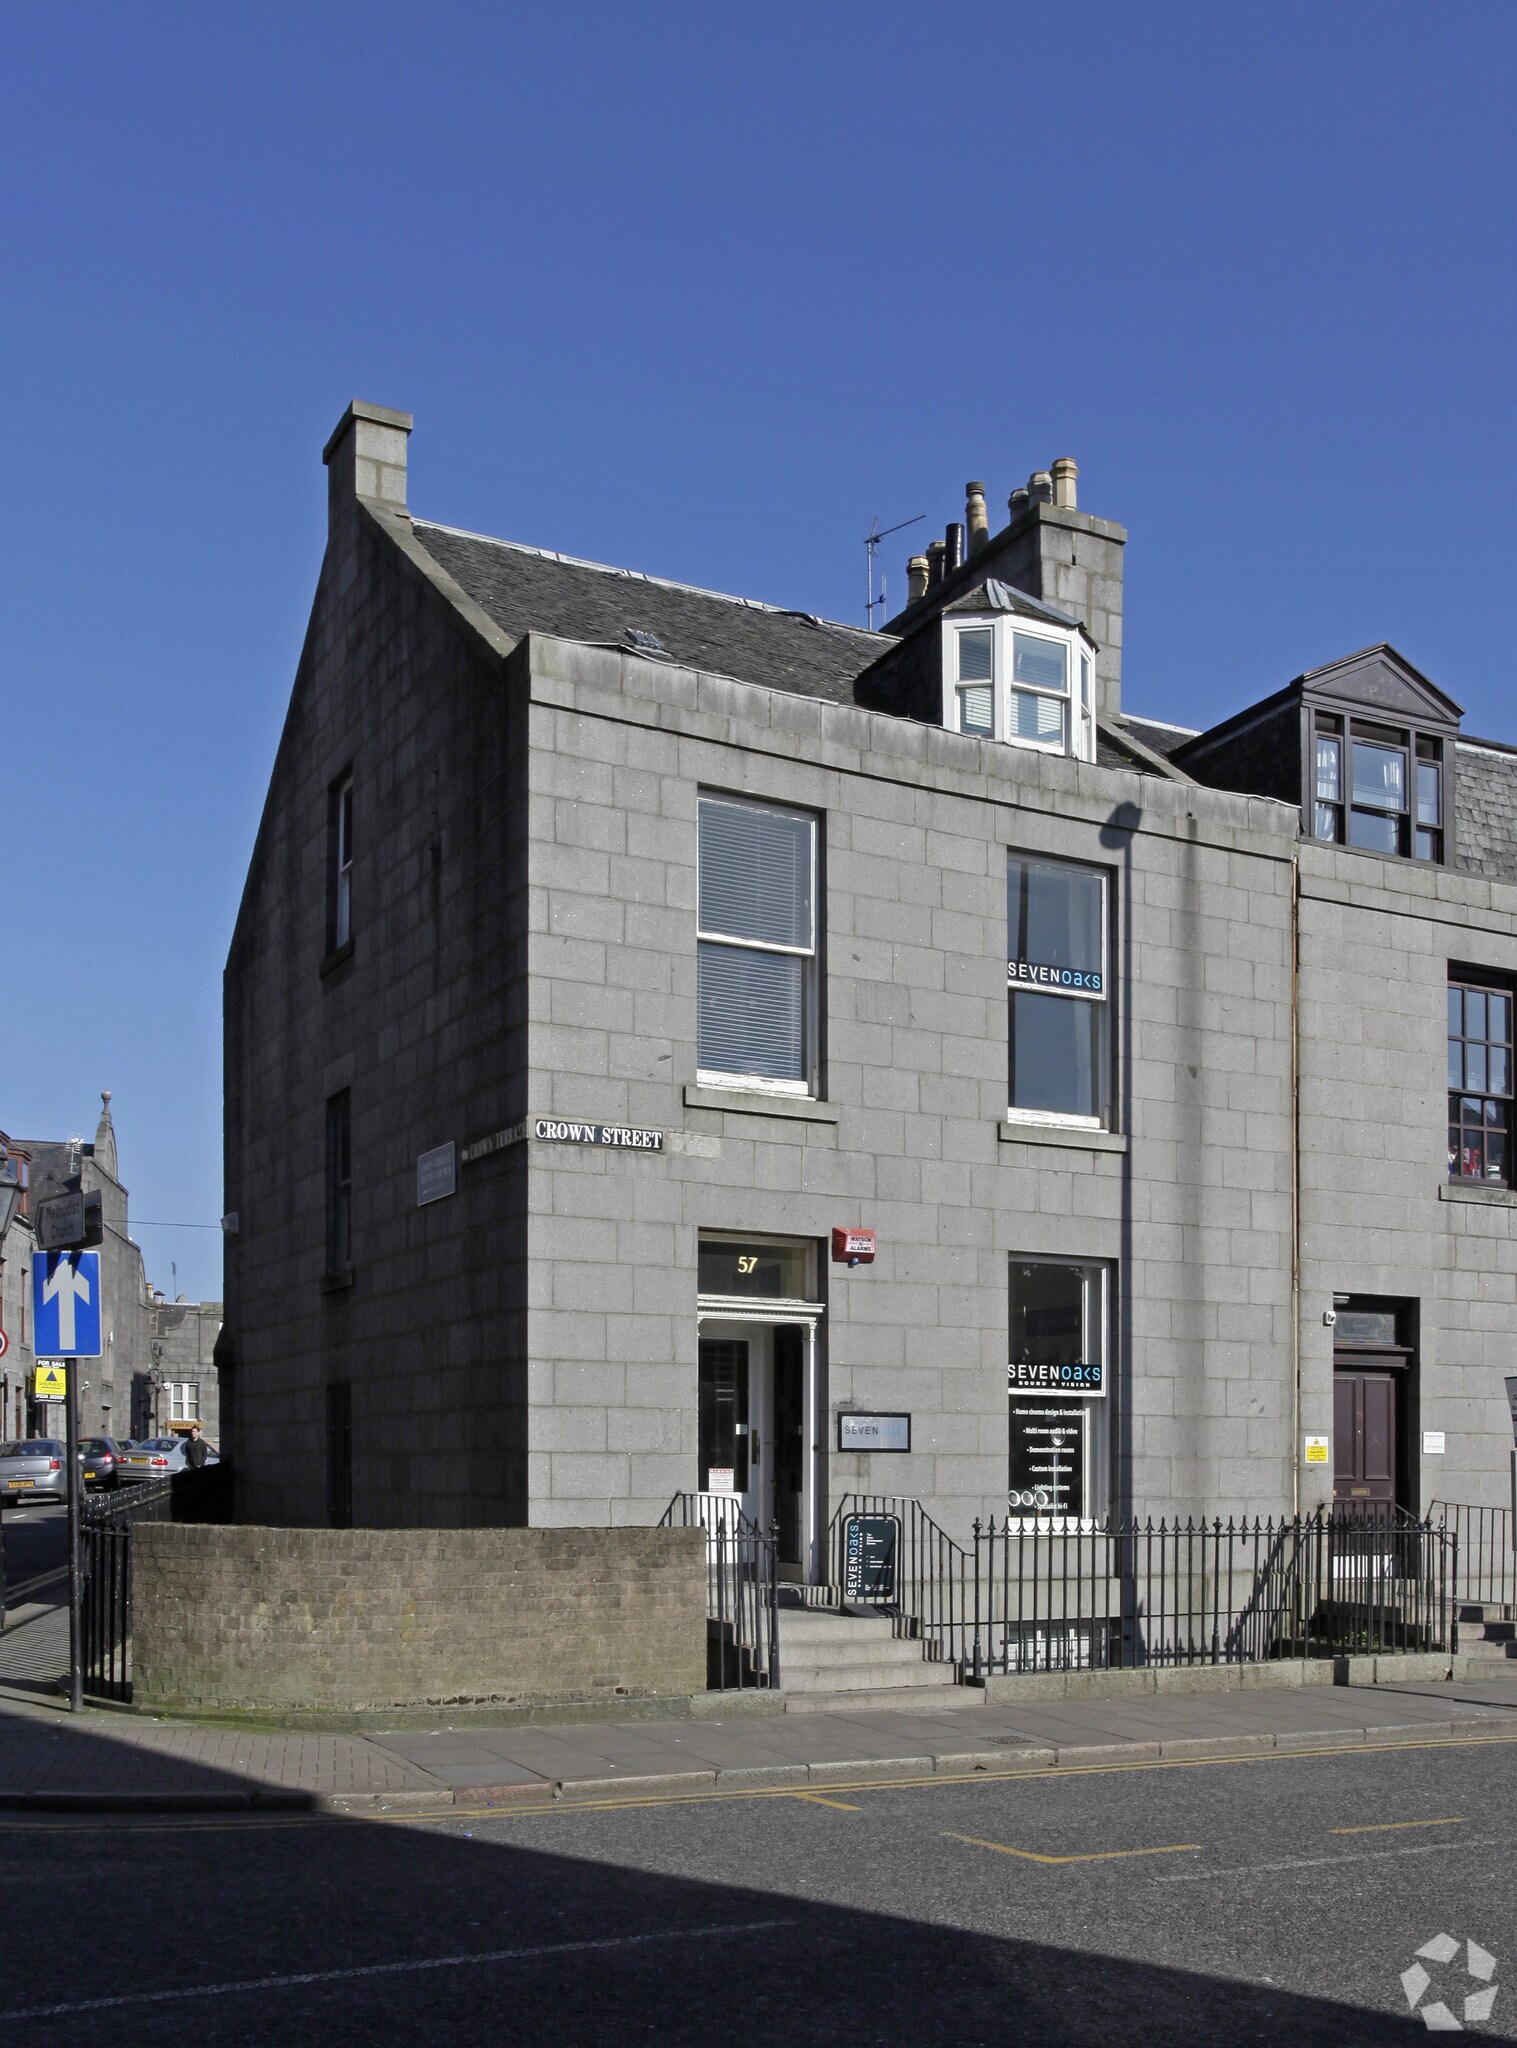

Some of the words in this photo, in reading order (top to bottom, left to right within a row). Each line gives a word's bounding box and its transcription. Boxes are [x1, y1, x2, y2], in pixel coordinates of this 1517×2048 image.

[535, 1120, 596, 1142] CROWN
[601, 1127, 662, 1148] STREET
[45, 1200, 80, 1221] Methodist
[51, 1221, 75, 1240] Church
[737, 1256, 758, 1273] 57
[1045, 1408, 1059, 1418] design
[1025, 1427, 1038, 1435] Multi
[1065, 1427, 1078, 1435] video
[1034, 1484, 1053, 1492] Lighting
[1057, 1502, 1068, 1510] hi-fi
